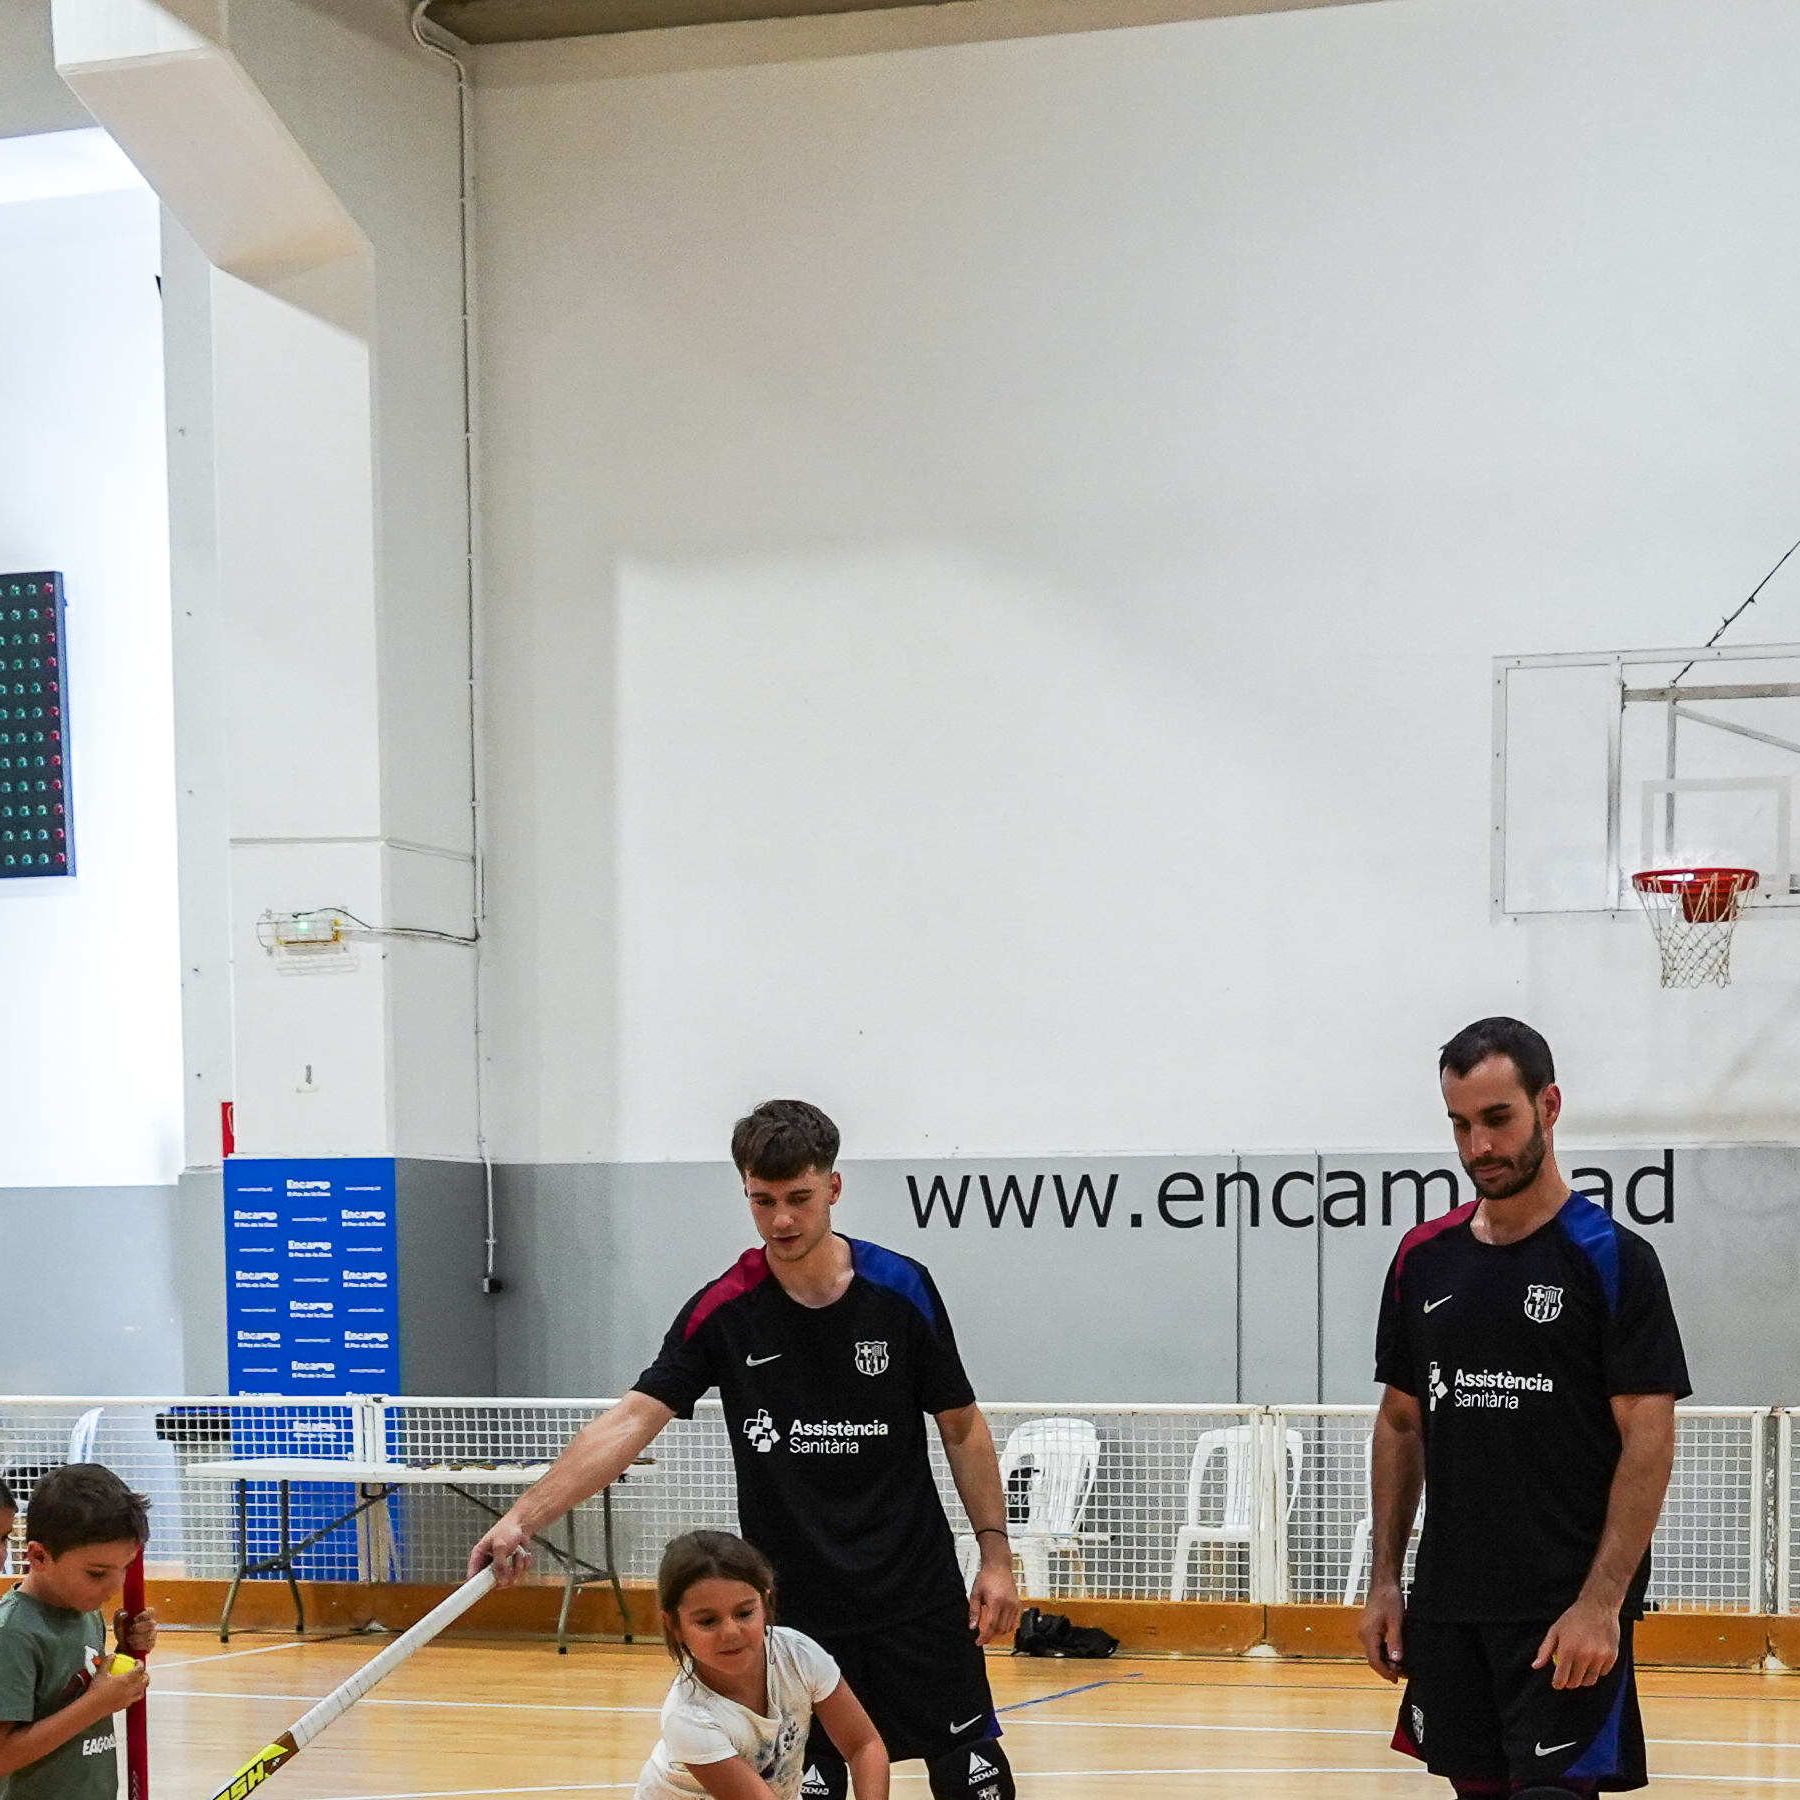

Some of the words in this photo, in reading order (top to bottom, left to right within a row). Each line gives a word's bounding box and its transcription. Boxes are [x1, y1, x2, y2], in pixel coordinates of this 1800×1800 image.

[1454, 1368, 1553, 1393] Assistència
[1454, 1388, 1519, 1410] Sanitària
[789, 1418, 889, 1437] Assistència
[789, 1437, 860, 1455] Sanitària
